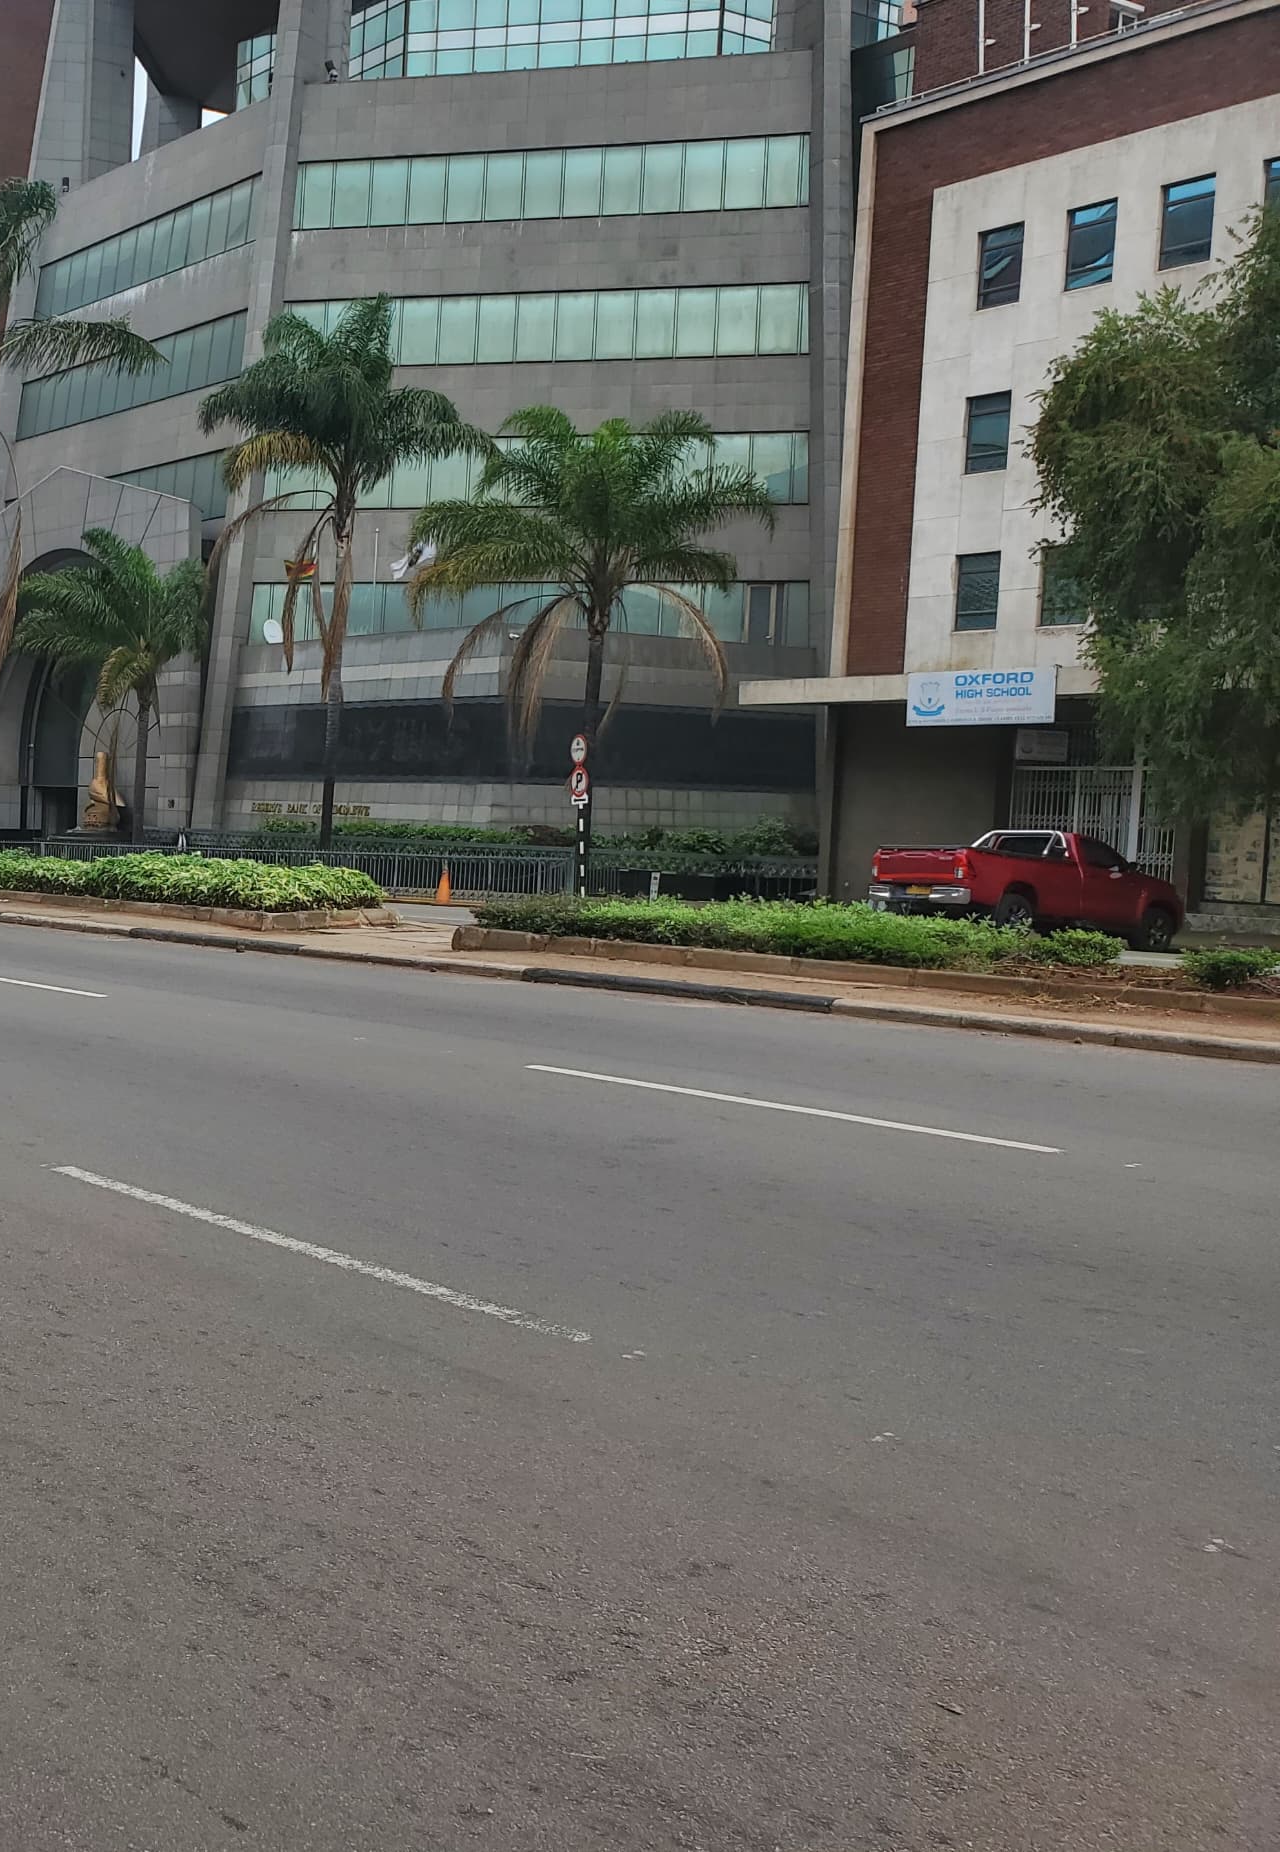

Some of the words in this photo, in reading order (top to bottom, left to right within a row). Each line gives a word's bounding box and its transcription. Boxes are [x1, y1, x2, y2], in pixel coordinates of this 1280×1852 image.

[955, 672, 1034, 686] OXFORD
[955, 689, 983, 699] HIGH
[986, 686, 1032, 697] SCHOOL
[287, 803, 308, 814] BANK
